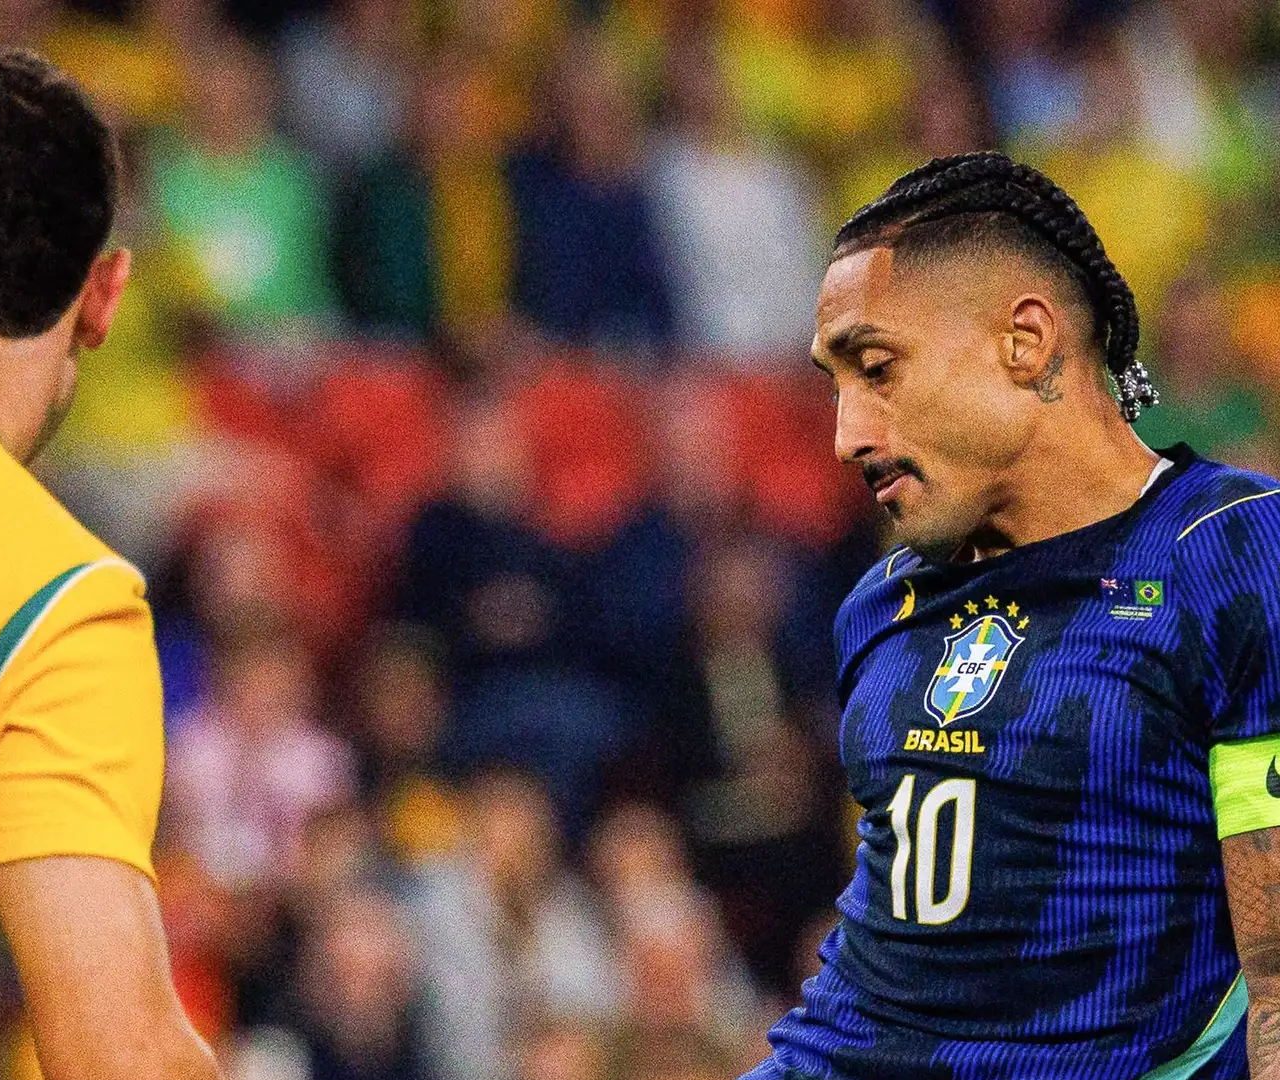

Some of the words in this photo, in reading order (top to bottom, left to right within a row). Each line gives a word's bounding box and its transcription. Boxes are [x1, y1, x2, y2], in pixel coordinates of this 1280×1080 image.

[957, 662, 987, 676] CBF
[904, 729, 986, 754] BRASIL
[886, 774, 976, 926] 10
